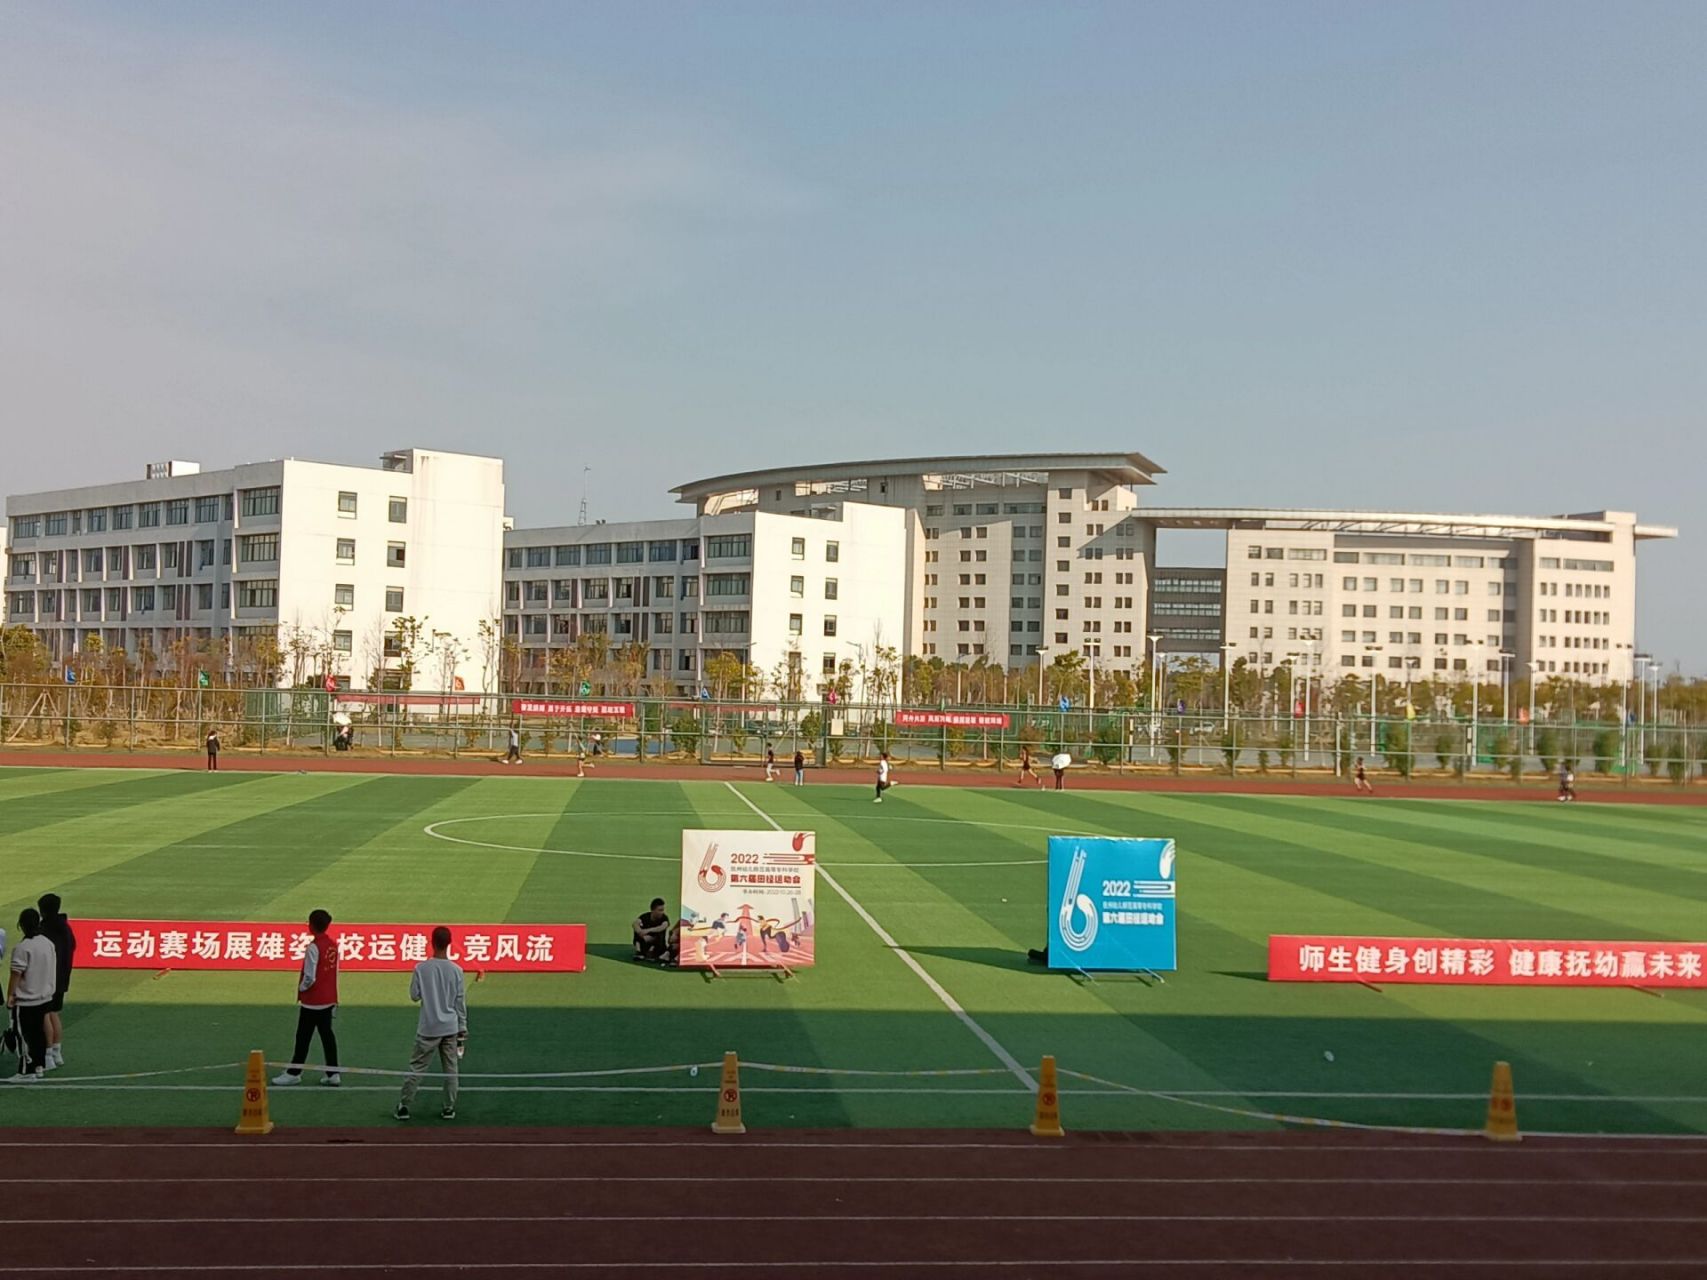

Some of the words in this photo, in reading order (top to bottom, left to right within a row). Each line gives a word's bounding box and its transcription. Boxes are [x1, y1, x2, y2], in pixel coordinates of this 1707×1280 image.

[730, 853, 759, 864] 2022
[730, 874, 801, 884] 第六届田径运动会
[1102, 879, 1131, 897] 2022
[93, 930, 315, 961] 运动赛场展雄姿
[1299, 944, 1495, 976] 师生健身创精彩
[1509, 948, 1702, 979] 健康抚幼赢未来
